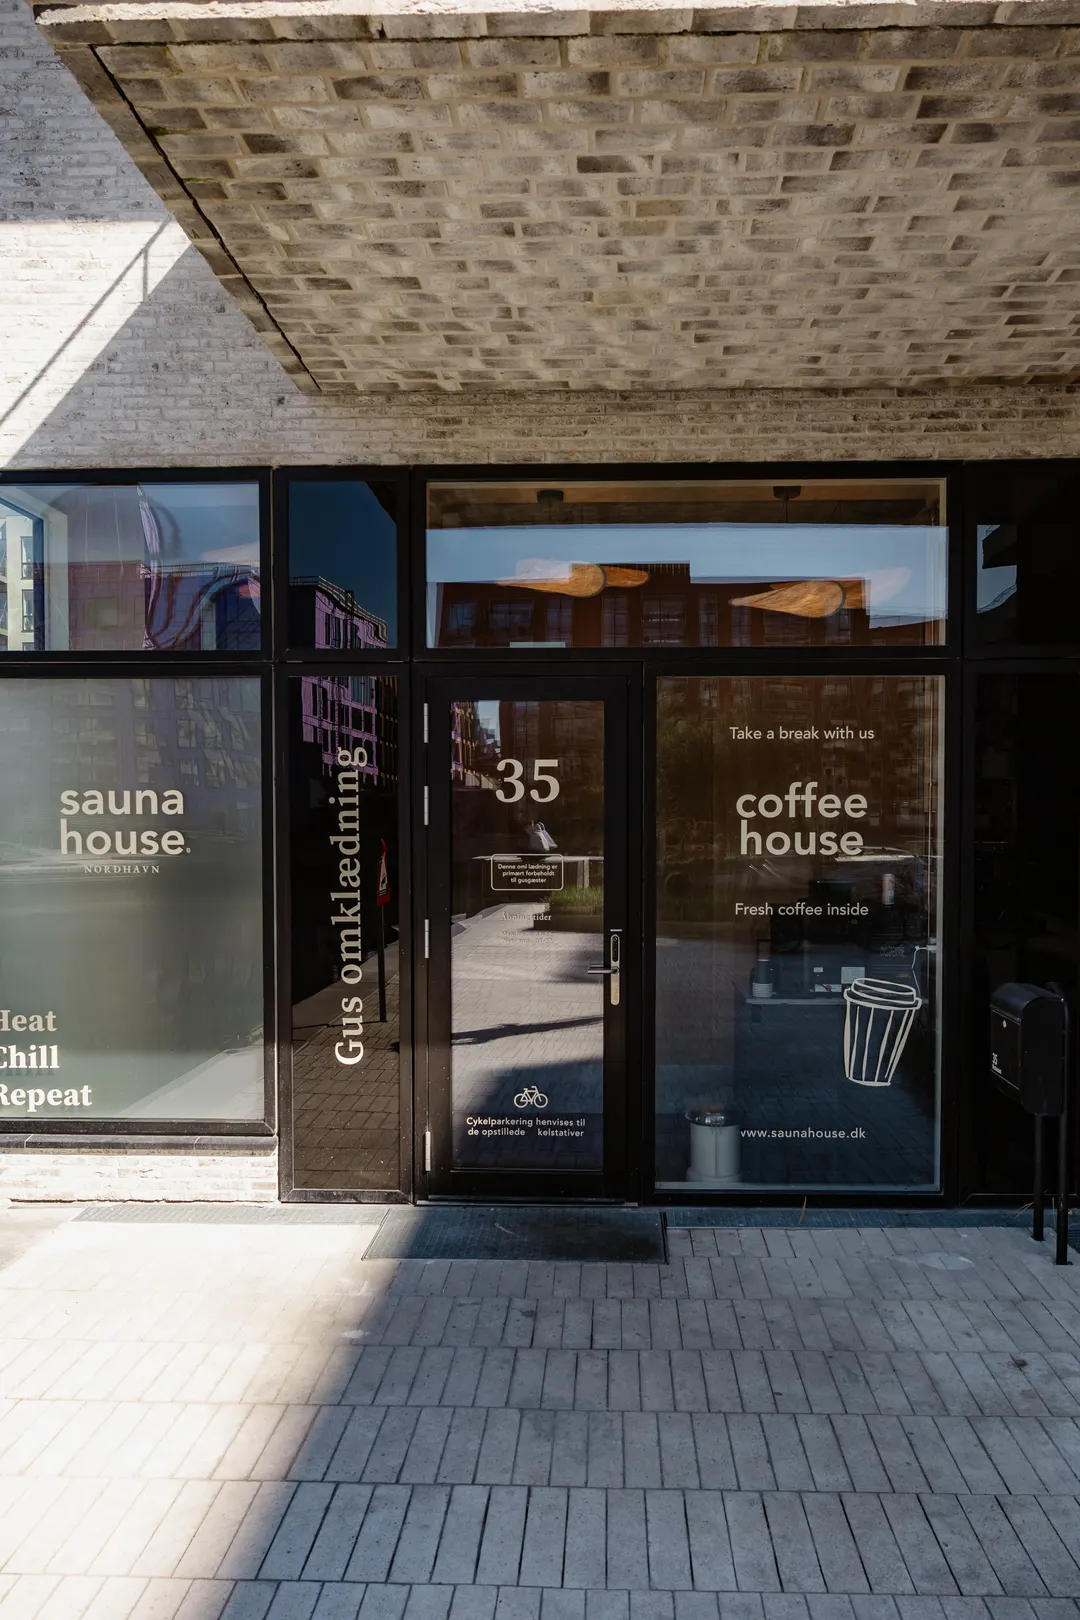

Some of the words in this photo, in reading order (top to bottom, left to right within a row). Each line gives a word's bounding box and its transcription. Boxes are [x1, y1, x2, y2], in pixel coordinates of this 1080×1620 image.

[729, 726, 762, 740] Take
[766, 730, 775, 740] a
[779, 726, 820, 740] break
[824, 726, 854, 740] with
[859, 730, 875, 740] us
[495, 758, 560, 803] 35
[60, 789, 184, 816] sauna
[735, 781, 868, 819] coffee
[740, 819, 864, 856] house
[84, 865, 160, 874] NORDHAVN
[328, 746, 368, 985] omklædning
[735, 902, 774, 916] Fresh
[778, 902, 823, 916] coffee
[827, 902, 869, 916] inside
[334, 996, 364, 1065] Gus
[466, 1116, 533, 1127] Cykelparkering
[536, 1117, 574, 1126] henvises
[576, 1118, 586, 1127] til
[467, 1127, 479, 1136] de
[482, 1127, 526, 1137] opstillede
